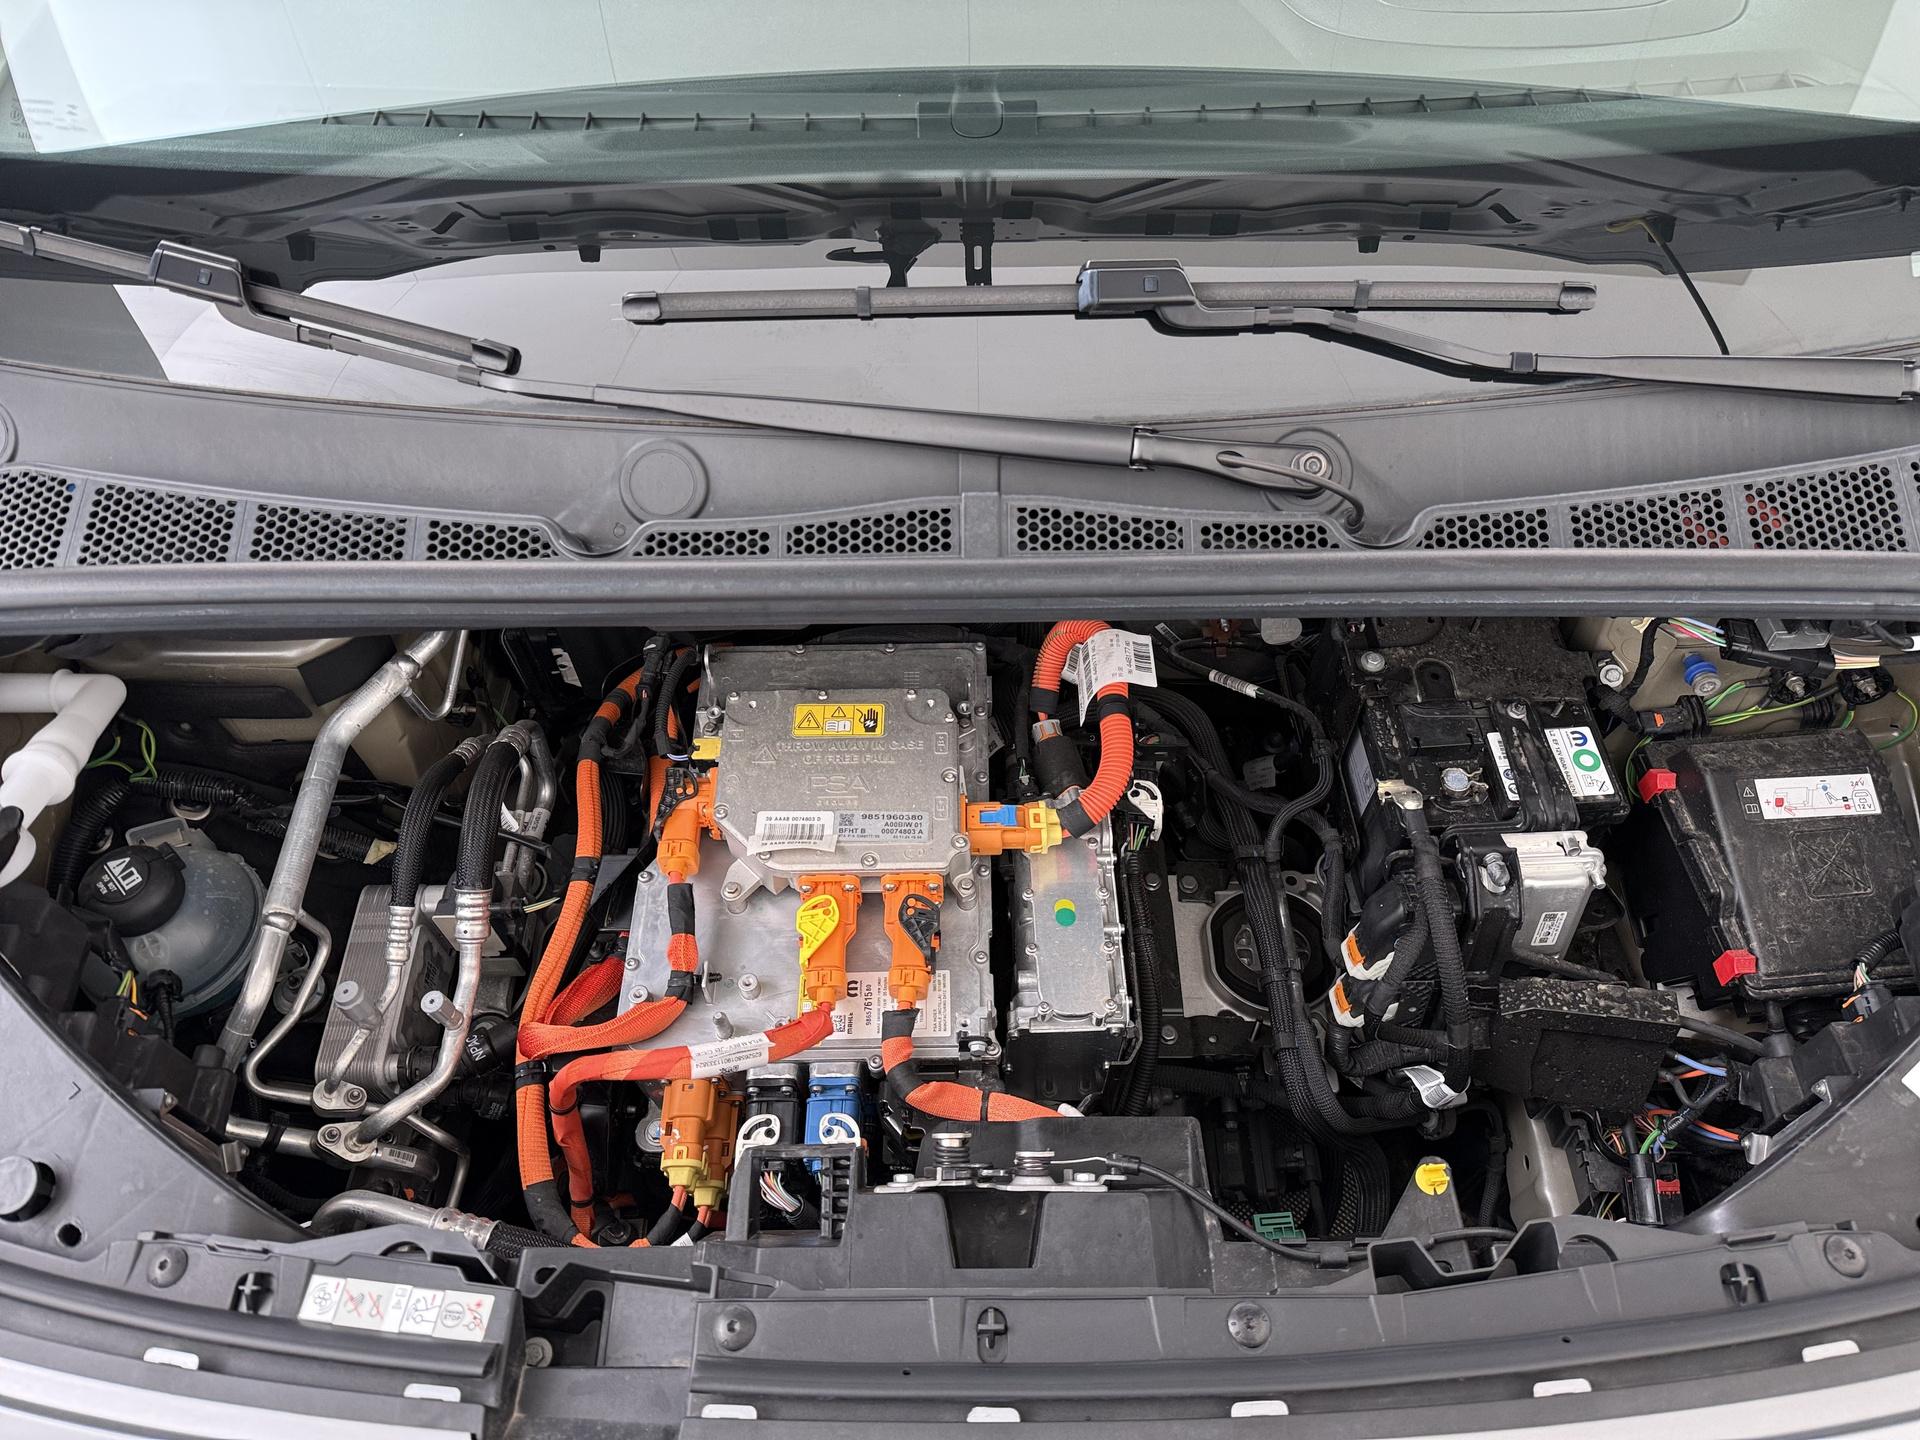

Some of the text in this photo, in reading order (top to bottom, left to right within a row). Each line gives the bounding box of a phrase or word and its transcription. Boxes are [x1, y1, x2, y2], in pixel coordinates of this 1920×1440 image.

[776, 740, 925, 752] THROW AWAY IN CASE
[802, 754, 896, 765] OF FREE FALL
[806, 774, 870, 794] PSA
[96, 882, 108, 895] OPEN
[102, 874, 118, 892] DO NOT
[466, 1034, 486, 1061] NPAC
